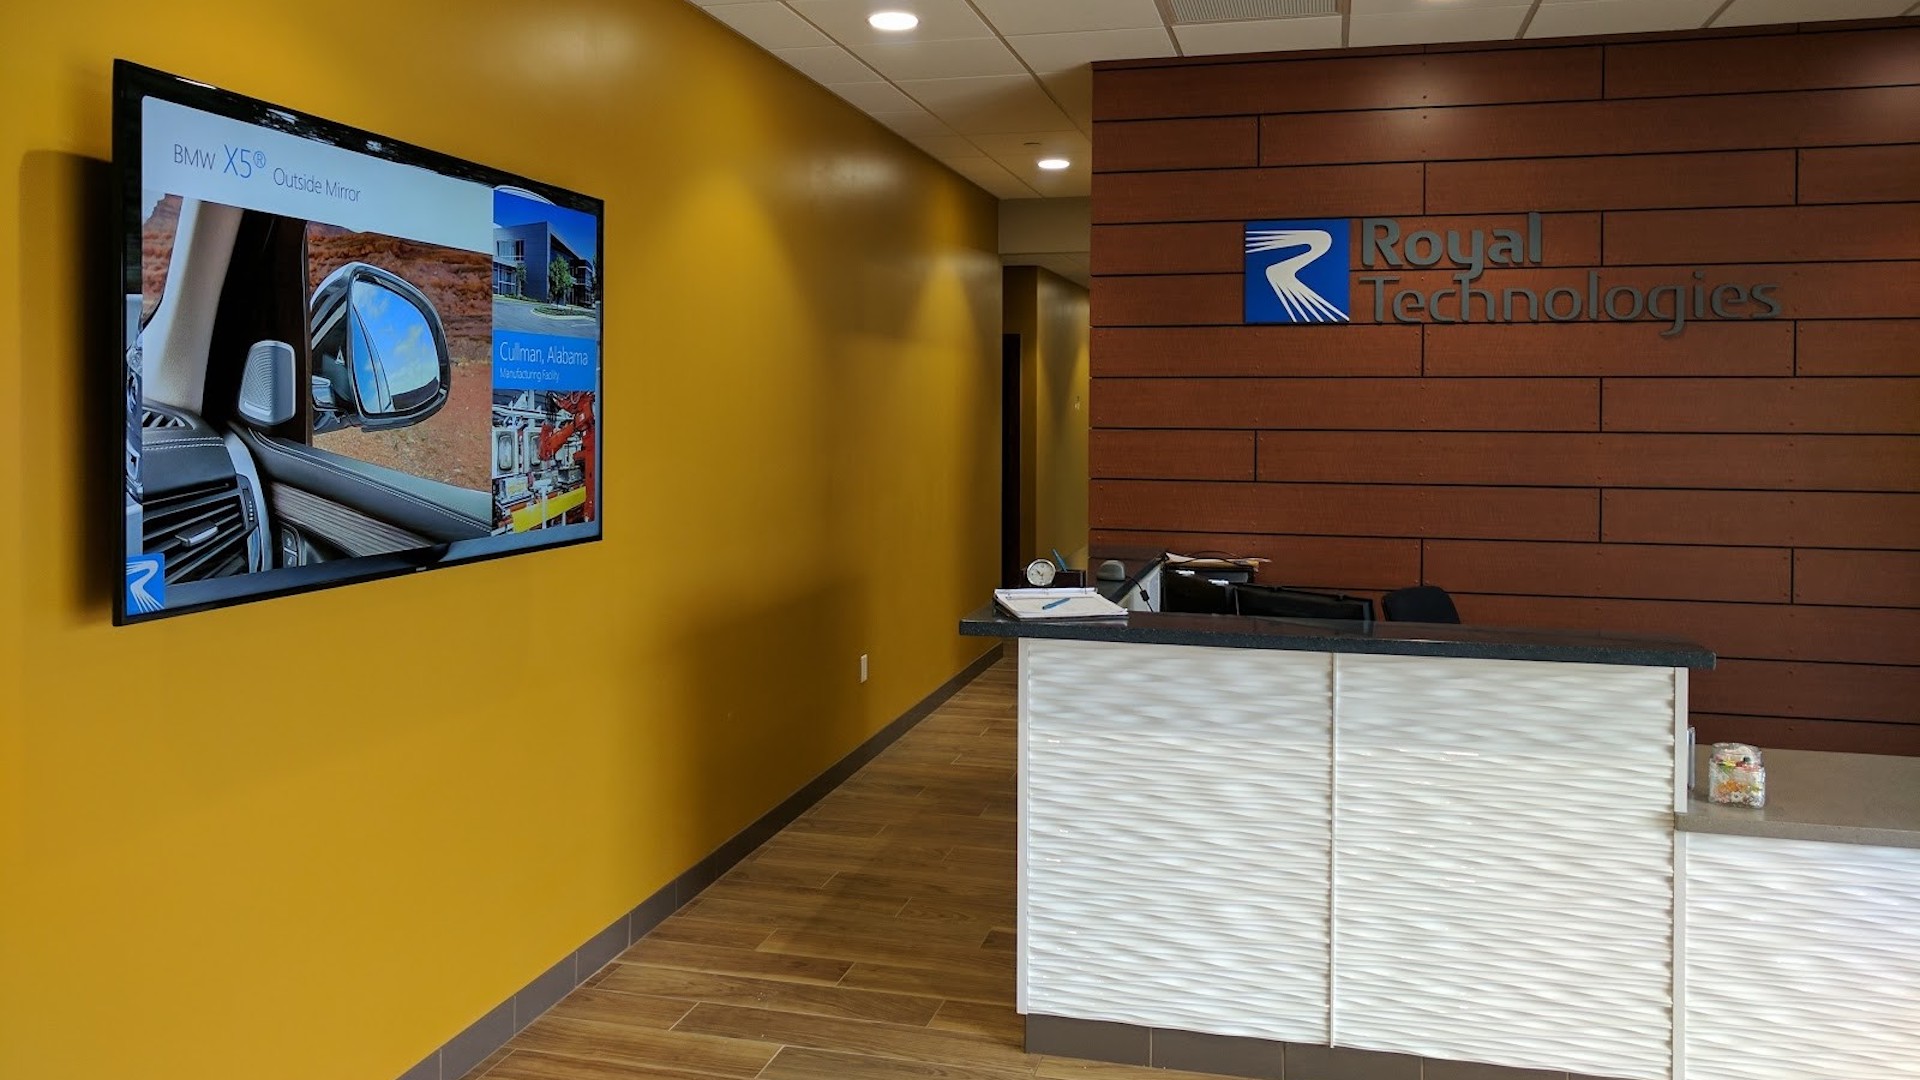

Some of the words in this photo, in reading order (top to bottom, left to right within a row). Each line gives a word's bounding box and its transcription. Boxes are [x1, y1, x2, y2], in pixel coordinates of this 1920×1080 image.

[173, 143, 216, 170] BMW
[273, 167, 322, 194] Outside
[325, 179, 361, 202] Mirror
[1360, 211, 1542, 280] Royal
[1358, 270, 1783, 337] Technologies
[499, 367, 541, 382] Manufacturing
[547, 345, 588, 366] Alabama
